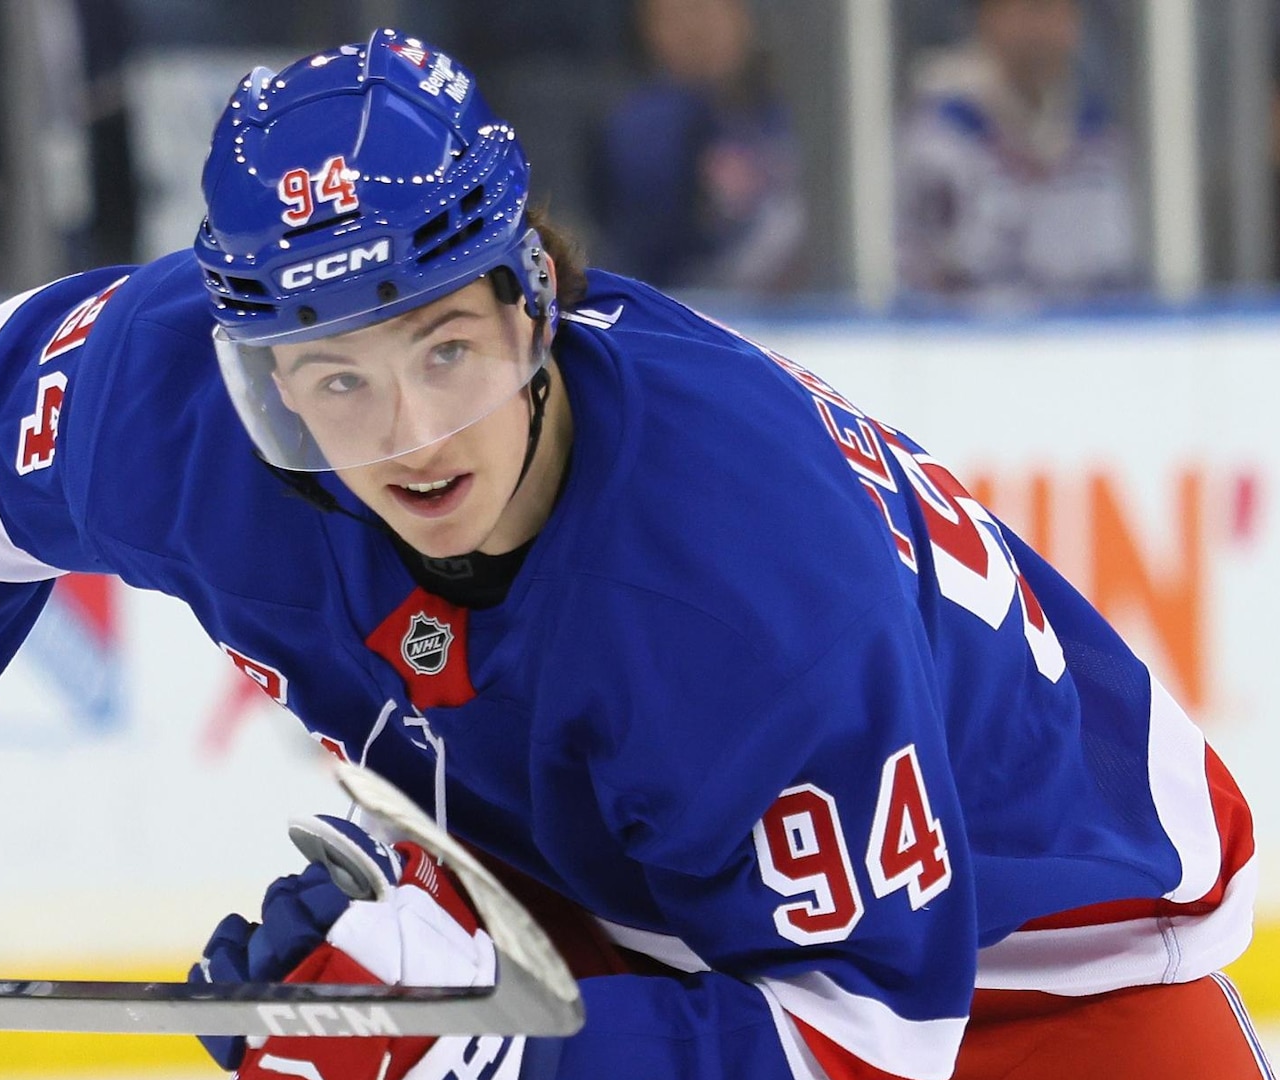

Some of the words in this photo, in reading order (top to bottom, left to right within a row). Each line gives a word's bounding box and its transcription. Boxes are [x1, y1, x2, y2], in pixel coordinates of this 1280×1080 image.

[277, 155, 360, 227] 94
[281, 239, 389, 290] CCM
[410, 635, 443, 657] NHL
[752, 744, 952, 946] 94
